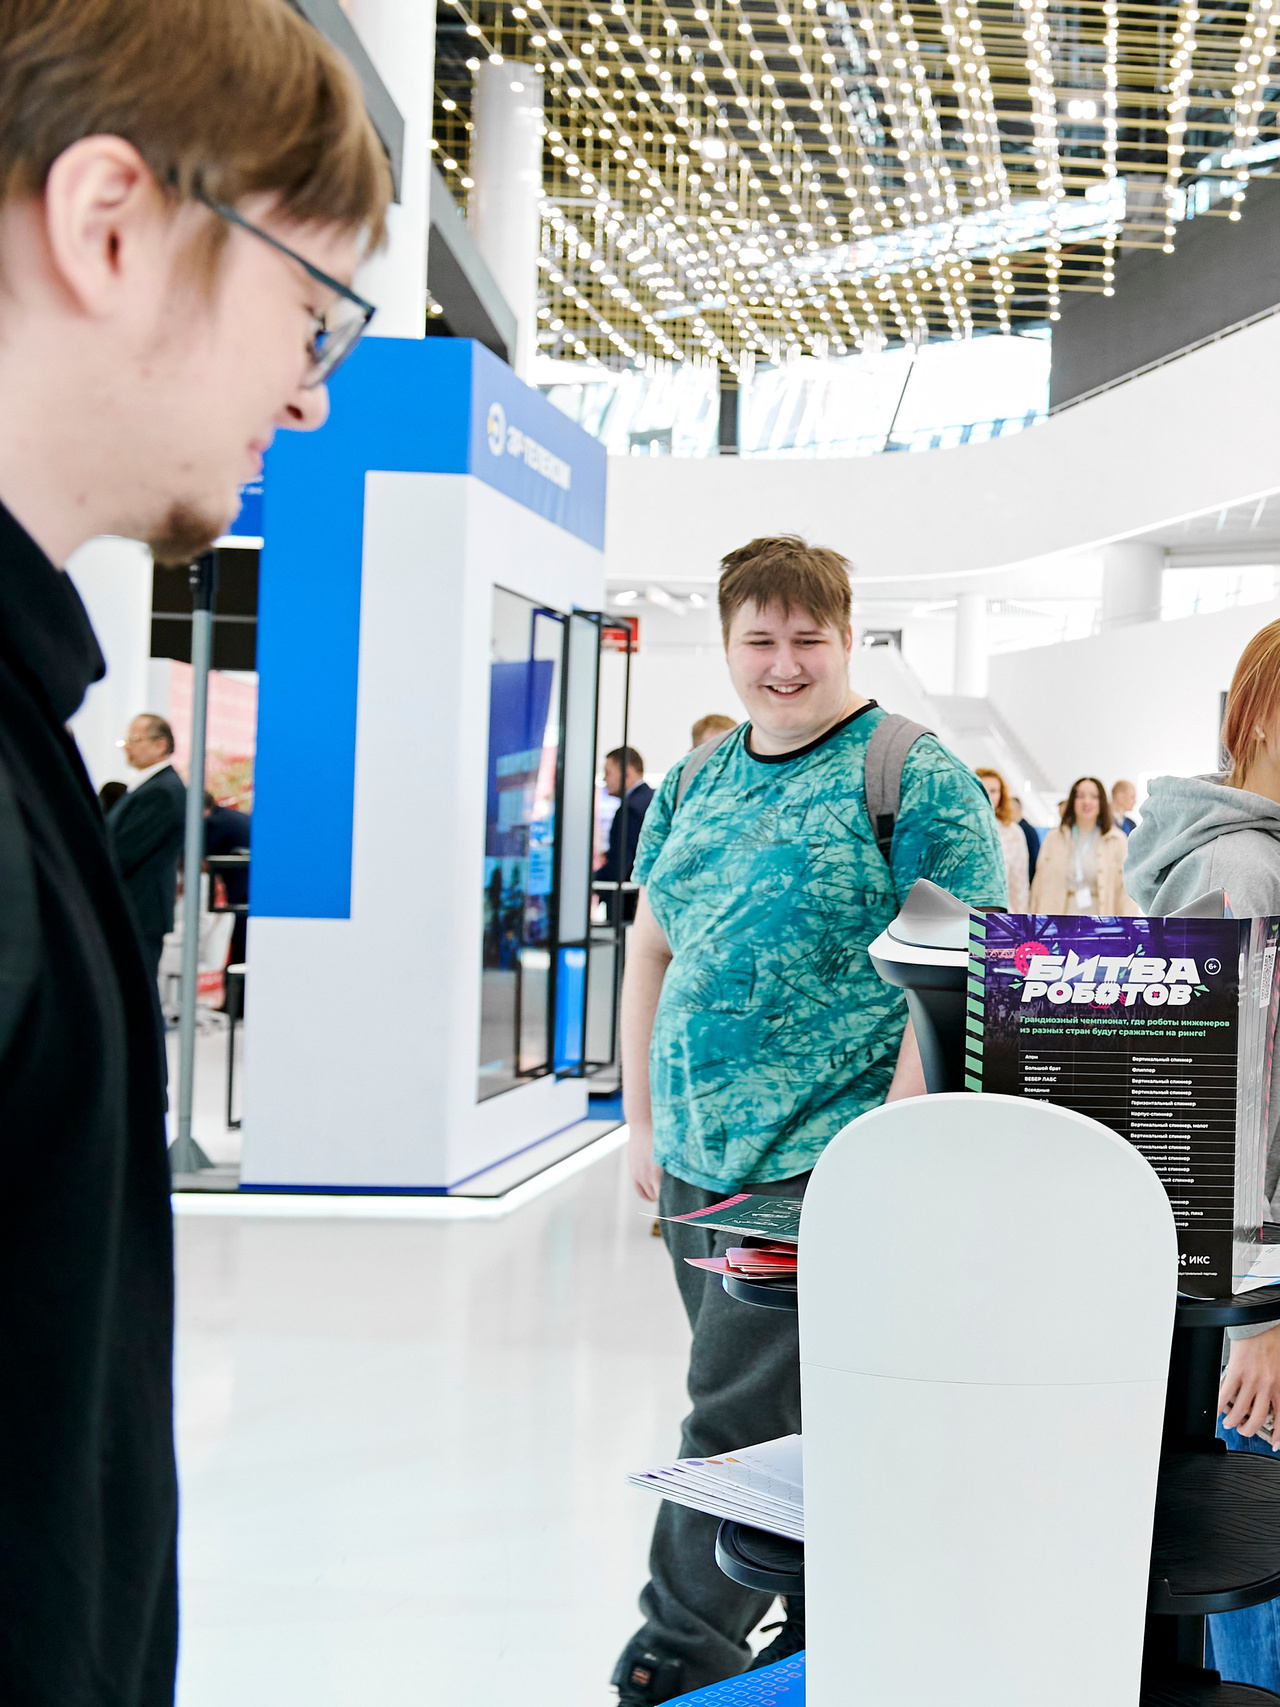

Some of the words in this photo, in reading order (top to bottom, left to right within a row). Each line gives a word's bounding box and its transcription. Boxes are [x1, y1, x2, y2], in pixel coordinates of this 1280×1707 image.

[1023, 949, 1201, 984] БИТВА
[1021, 980, 1193, 1006] РОБОТОВ
[1020, 1015, 1078, 1026] Грандиозный
[1080, 1018, 1128, 1027] чемпионат,
[1130, 1019, 1146, 1027] где
[1147, 1018, 1179, 1028] роботы
[1181, 1020, 1230, 1028] инженеров
[1032, 1028, 1063, 1036] разных
[1066, 1029, 1090, 1037] стран
[1092, 1027, 1117, 1037] будут
[1119, 1029, 1164, 1037] сражаться
[1178, 1029, 1206, 1038] ринге!
[1189, 1256, 1211, 1264] ИКС
